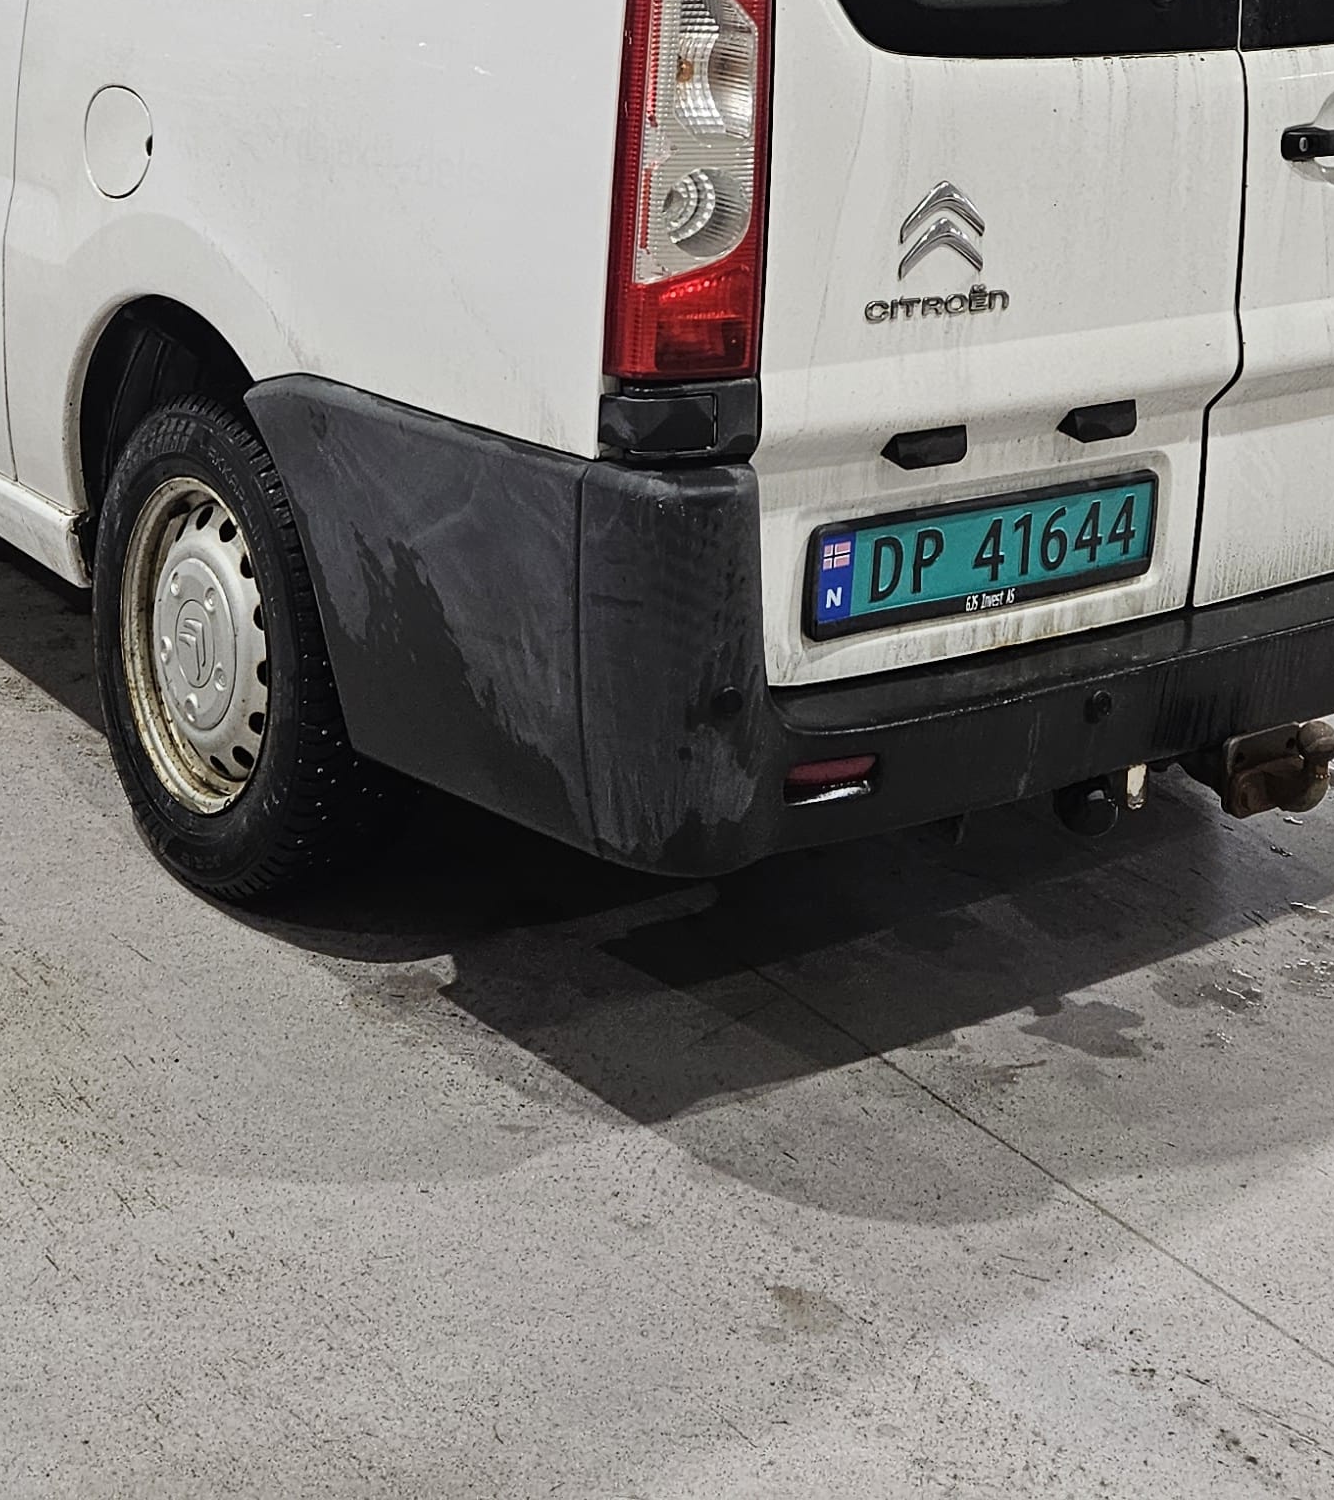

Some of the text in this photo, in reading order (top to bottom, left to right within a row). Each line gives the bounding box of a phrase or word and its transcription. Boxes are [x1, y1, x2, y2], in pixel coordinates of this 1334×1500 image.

[870, 493, 1137, 603] DP 41644
[825, 586, 842, 609] N
[980, 590, 1004, 610] Invest
[1005, 587, 1016, 605] AS
